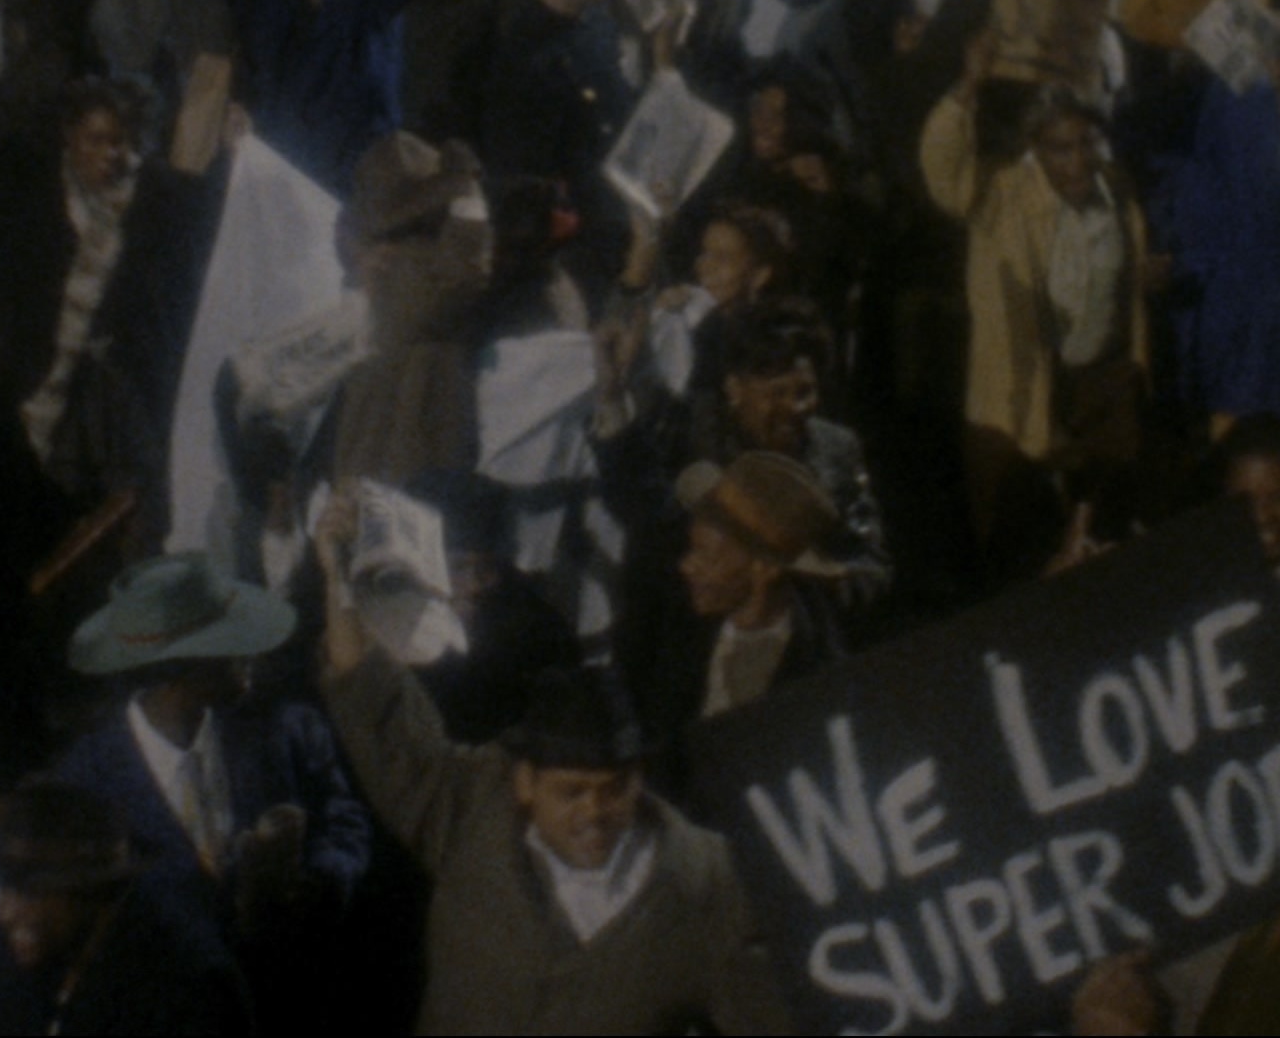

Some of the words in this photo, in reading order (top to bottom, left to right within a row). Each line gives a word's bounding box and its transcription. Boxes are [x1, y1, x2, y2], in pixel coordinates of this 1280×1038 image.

[746, 714, 962, 908] WE
[982, 599, 1265, 815] LOVE
[807, 830, 1155, 1035] SUPER
